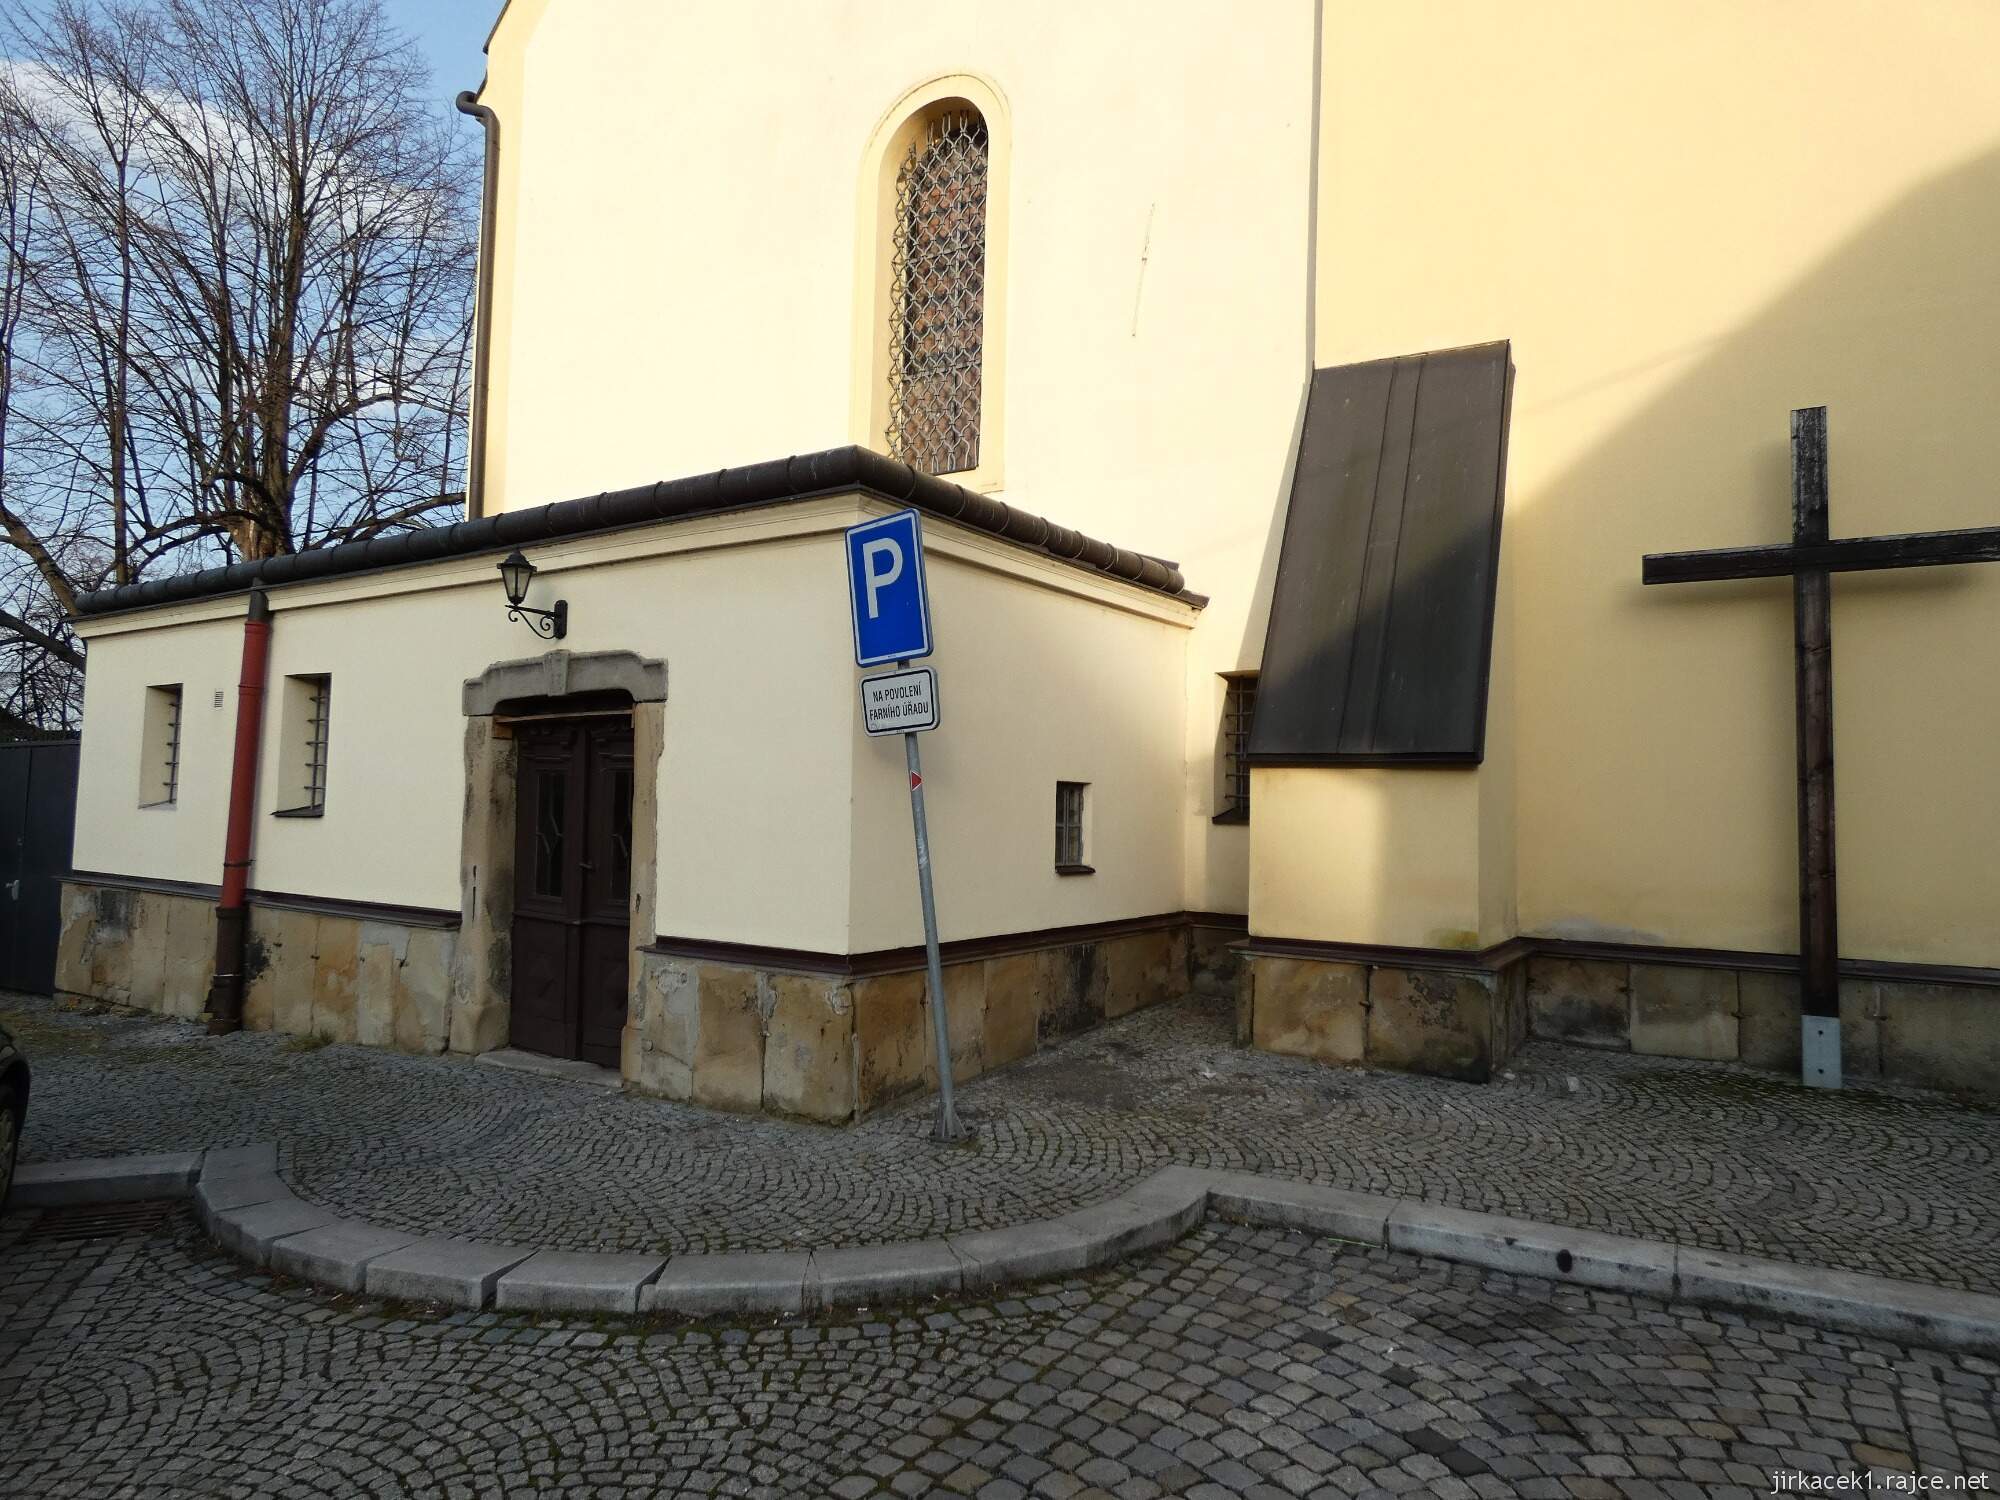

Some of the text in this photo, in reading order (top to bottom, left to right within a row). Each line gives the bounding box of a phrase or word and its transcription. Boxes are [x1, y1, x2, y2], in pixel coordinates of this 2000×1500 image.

[863, 537, 904, 619] P
[873, 681, 921, 702] NA POVOLENÍ
[869, 700, 929, 721] FARNÍHO ÚŘADU
